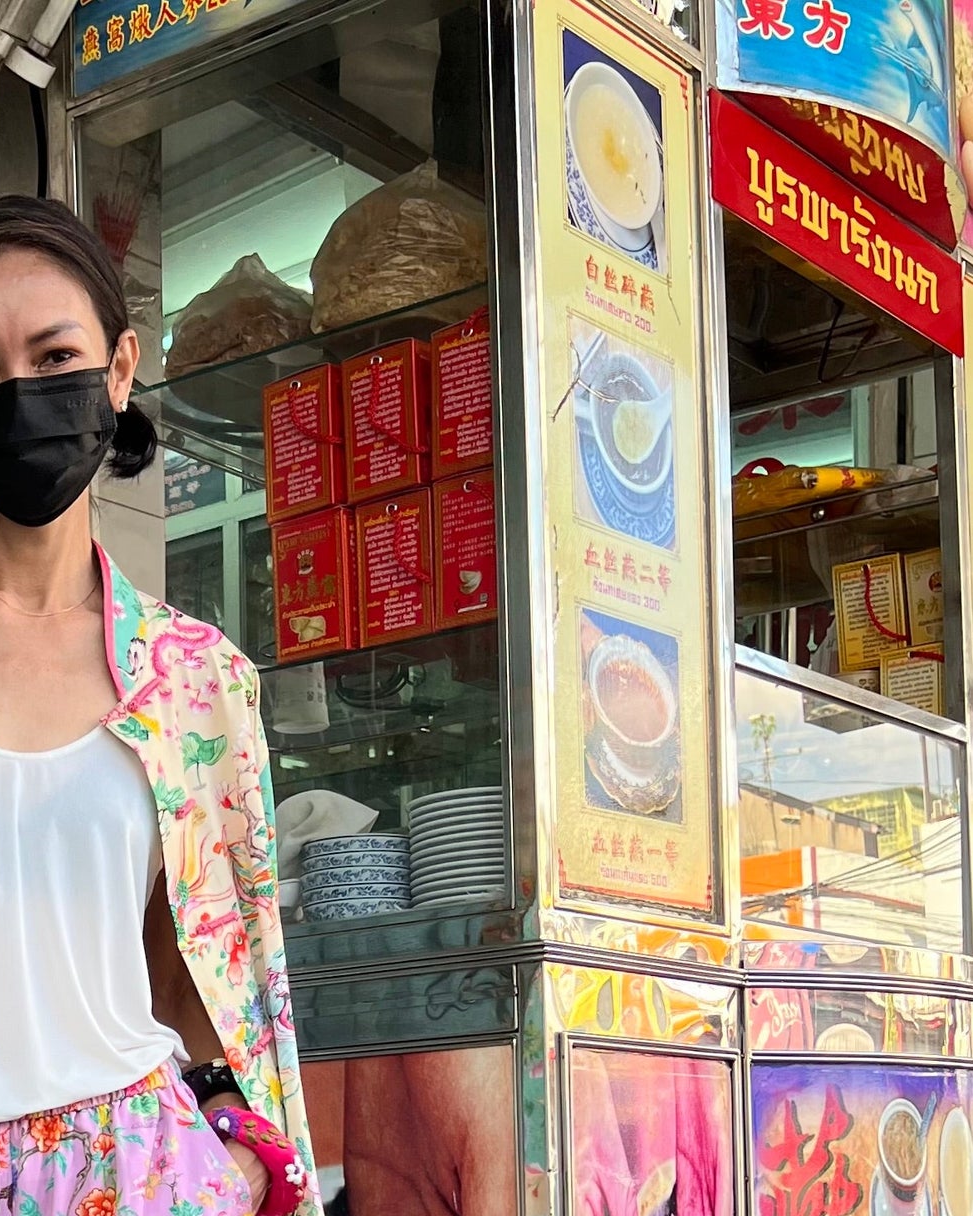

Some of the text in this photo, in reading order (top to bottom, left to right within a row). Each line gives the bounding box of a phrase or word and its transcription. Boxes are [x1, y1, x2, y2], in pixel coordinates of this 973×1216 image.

[739, 0, 849, 52] 東方
[746, 147, 940, 314] บูรพารังนก
